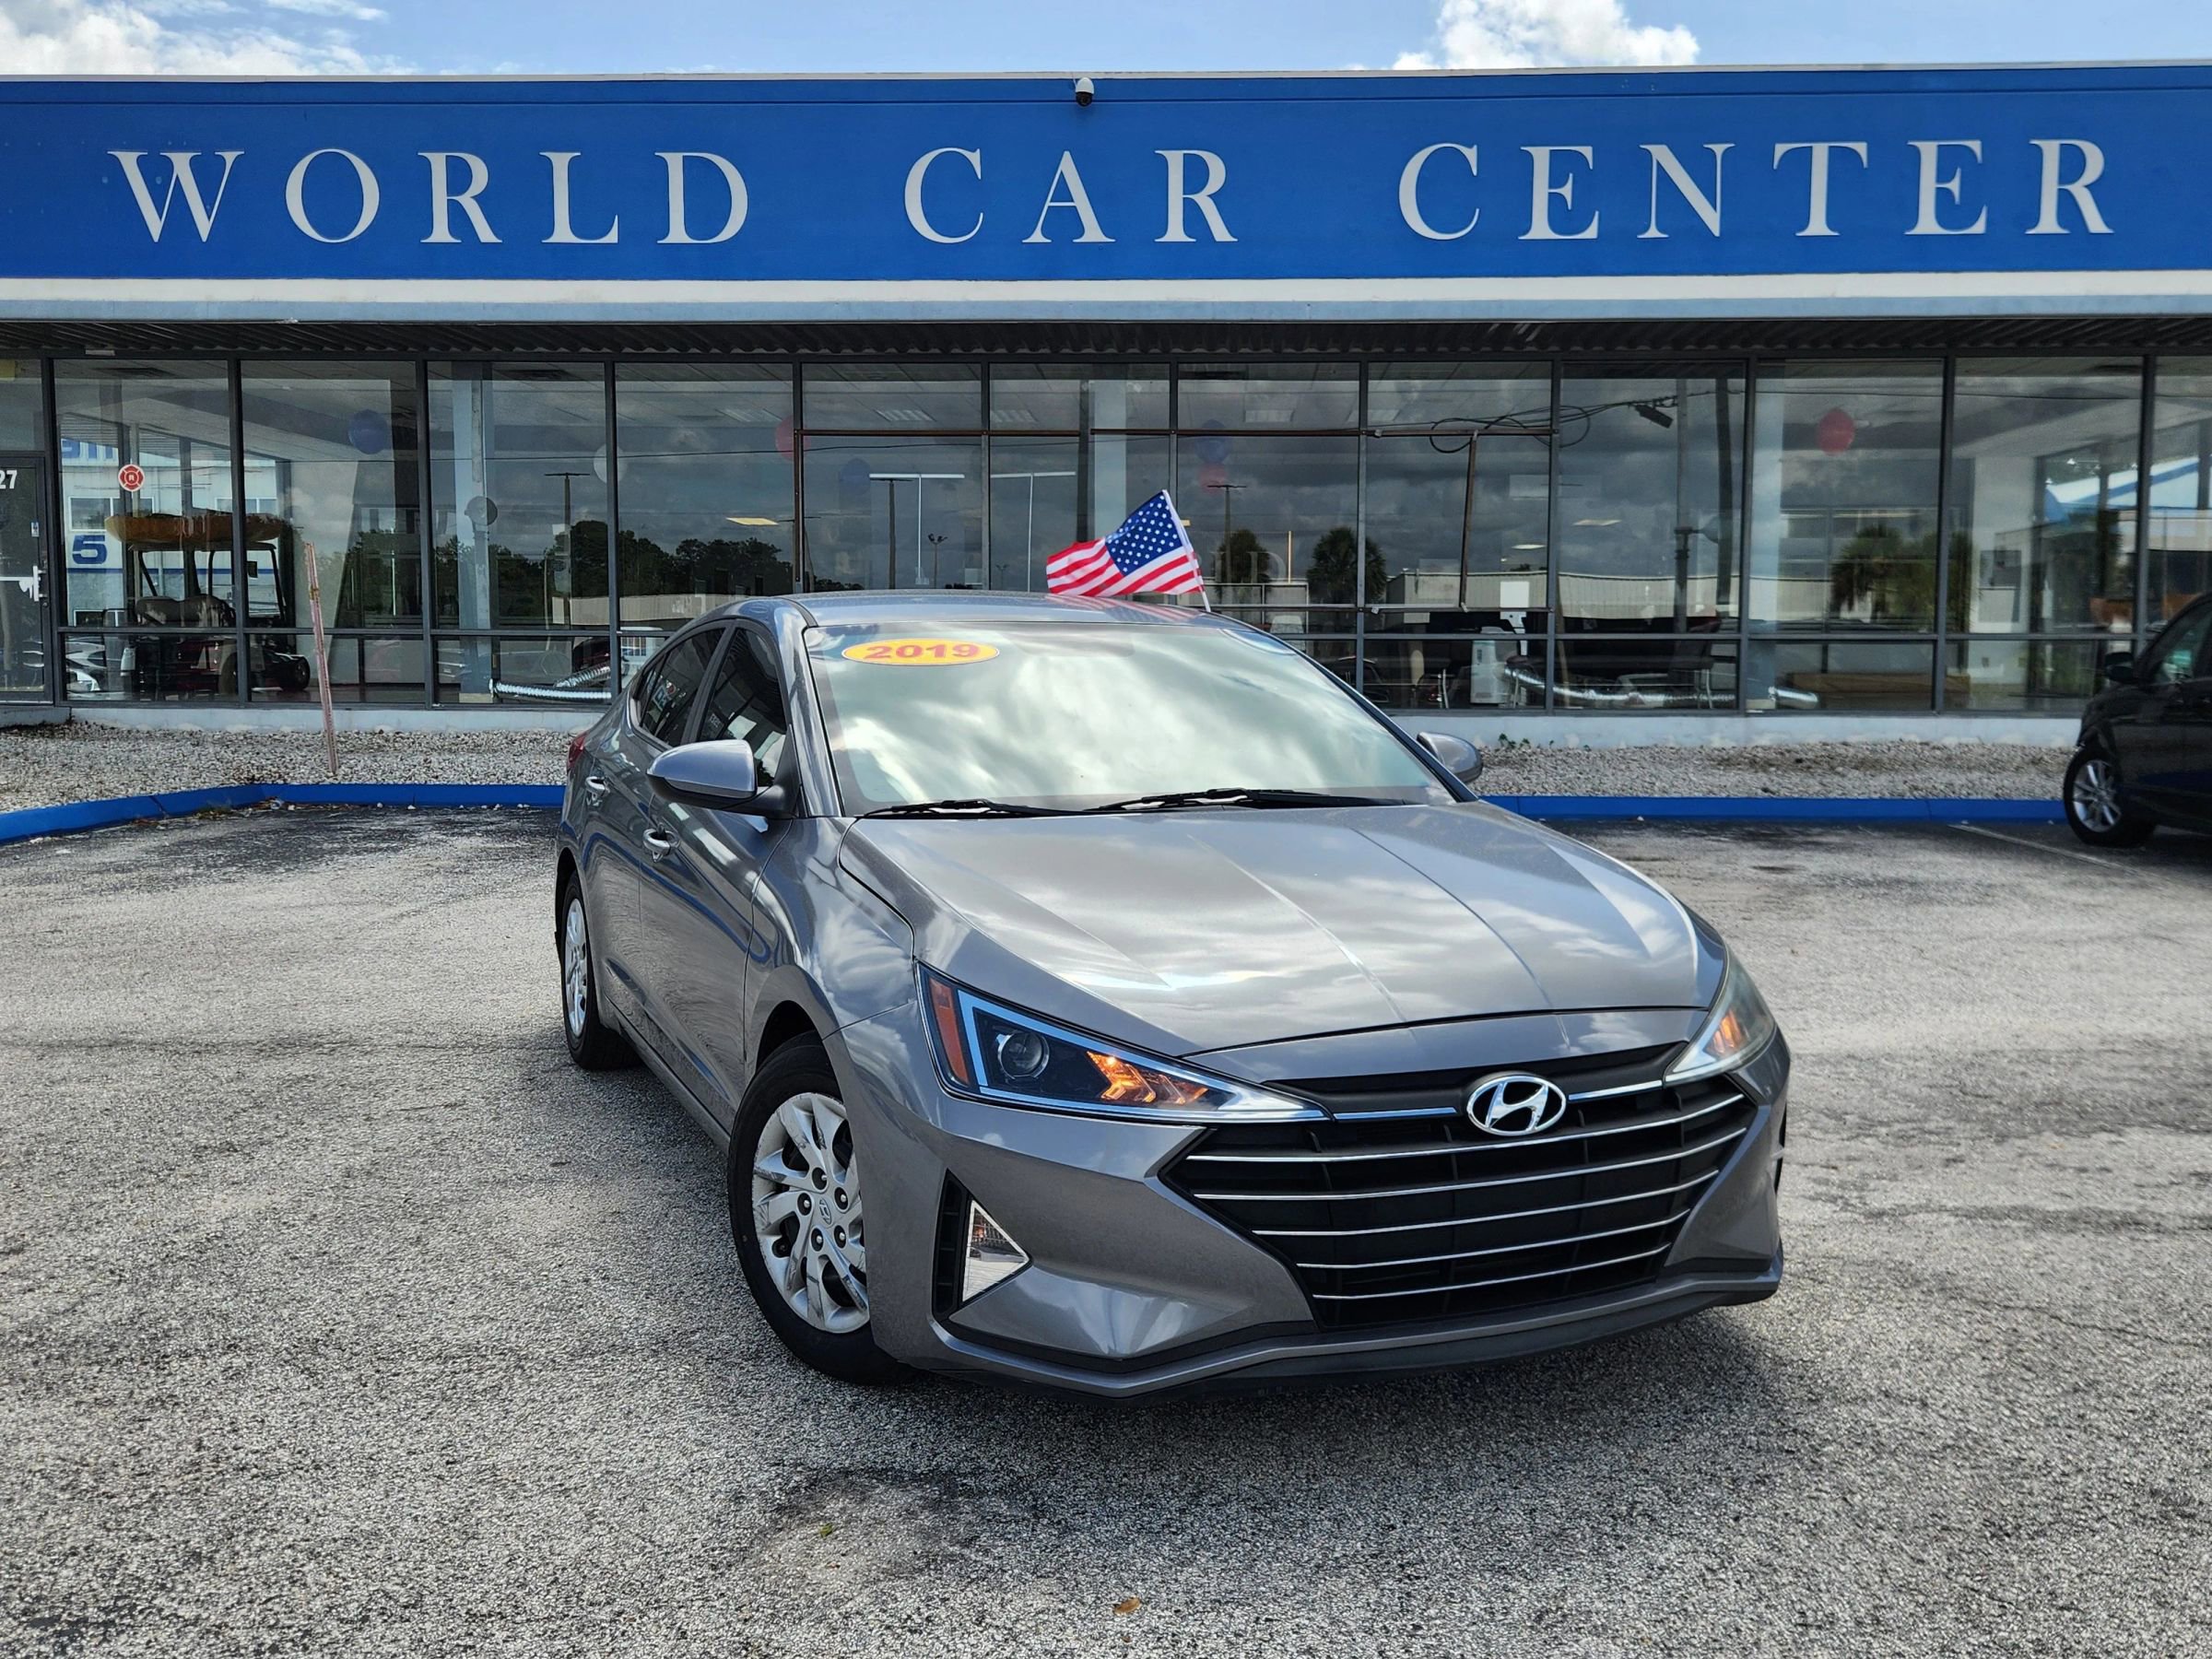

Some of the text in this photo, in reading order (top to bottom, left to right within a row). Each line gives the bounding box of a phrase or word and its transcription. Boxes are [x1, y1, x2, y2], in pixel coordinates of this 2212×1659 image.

[107, 138, 2115, 245] WORLD CAR CENTER
[72, 535, 108, 565] 5
[863, 642, 981, 660] 2019
